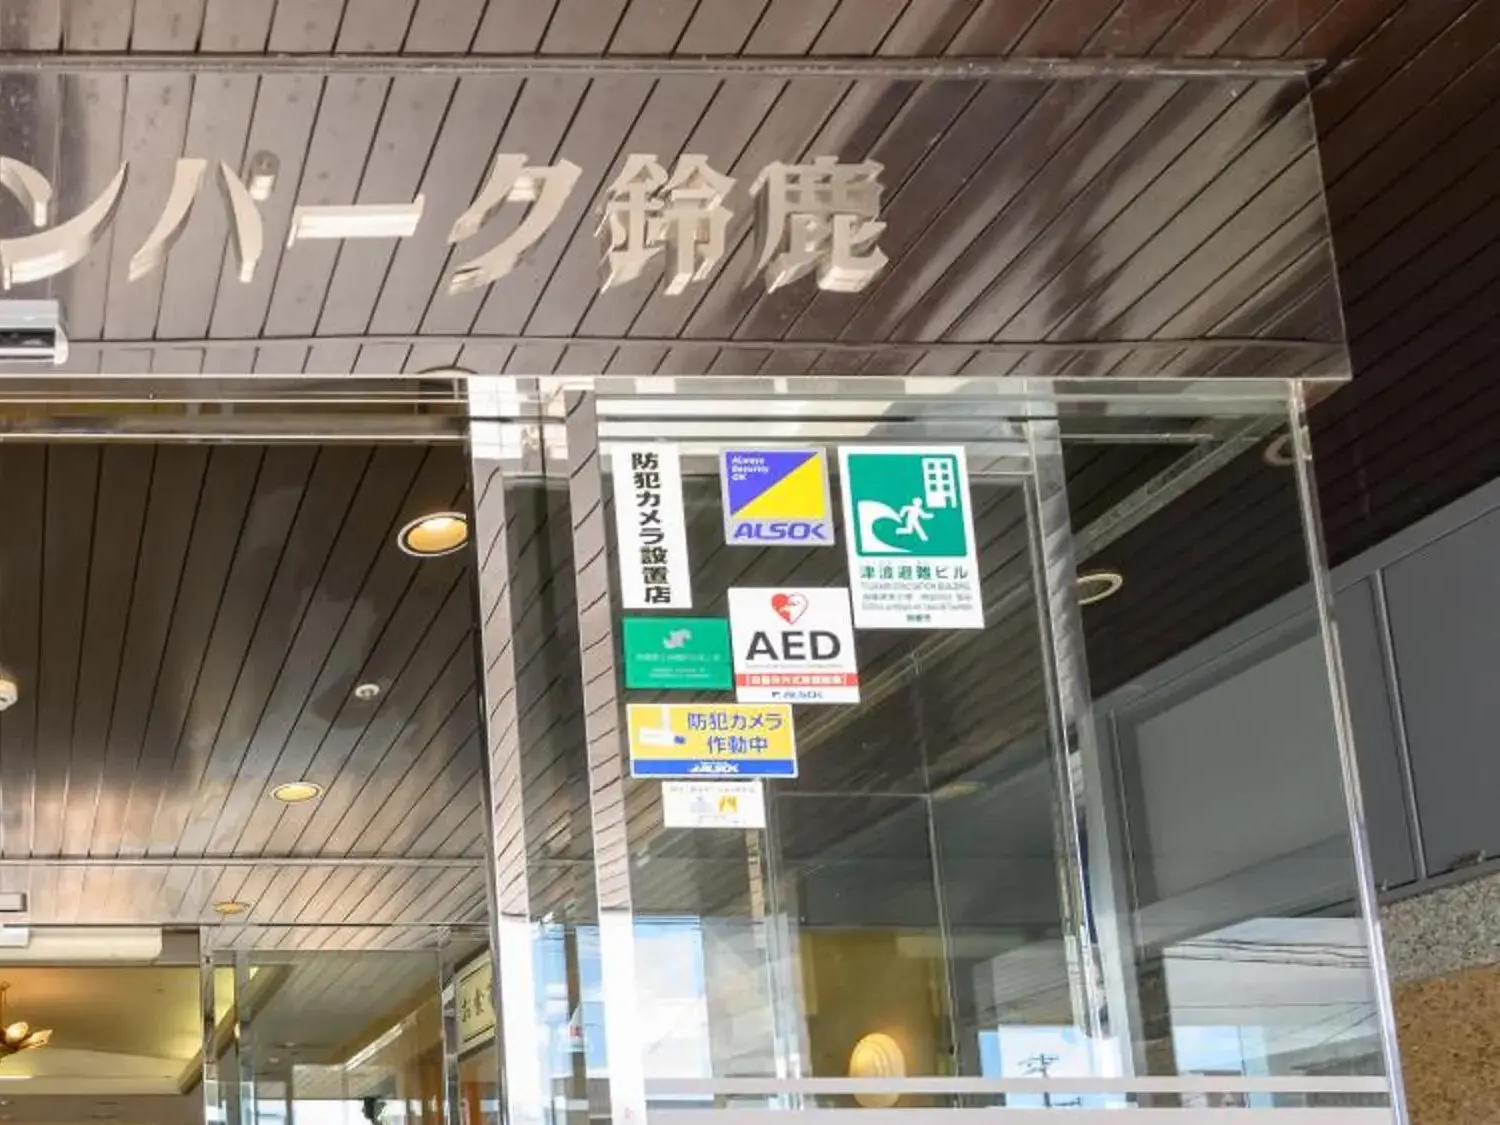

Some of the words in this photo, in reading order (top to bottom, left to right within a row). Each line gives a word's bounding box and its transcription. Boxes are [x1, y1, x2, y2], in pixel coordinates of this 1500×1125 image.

[630, 451, 672, 605] 防犯カメラ設置店
[733, 522, 828, 541] ALSOK
[860, 564, 968, 580] 津波避難ビル
[745, 630, 842, 662] AED
[687, 711, 784, 731] 防犯カメラ
[707, 735, 769, 754] 作動中
